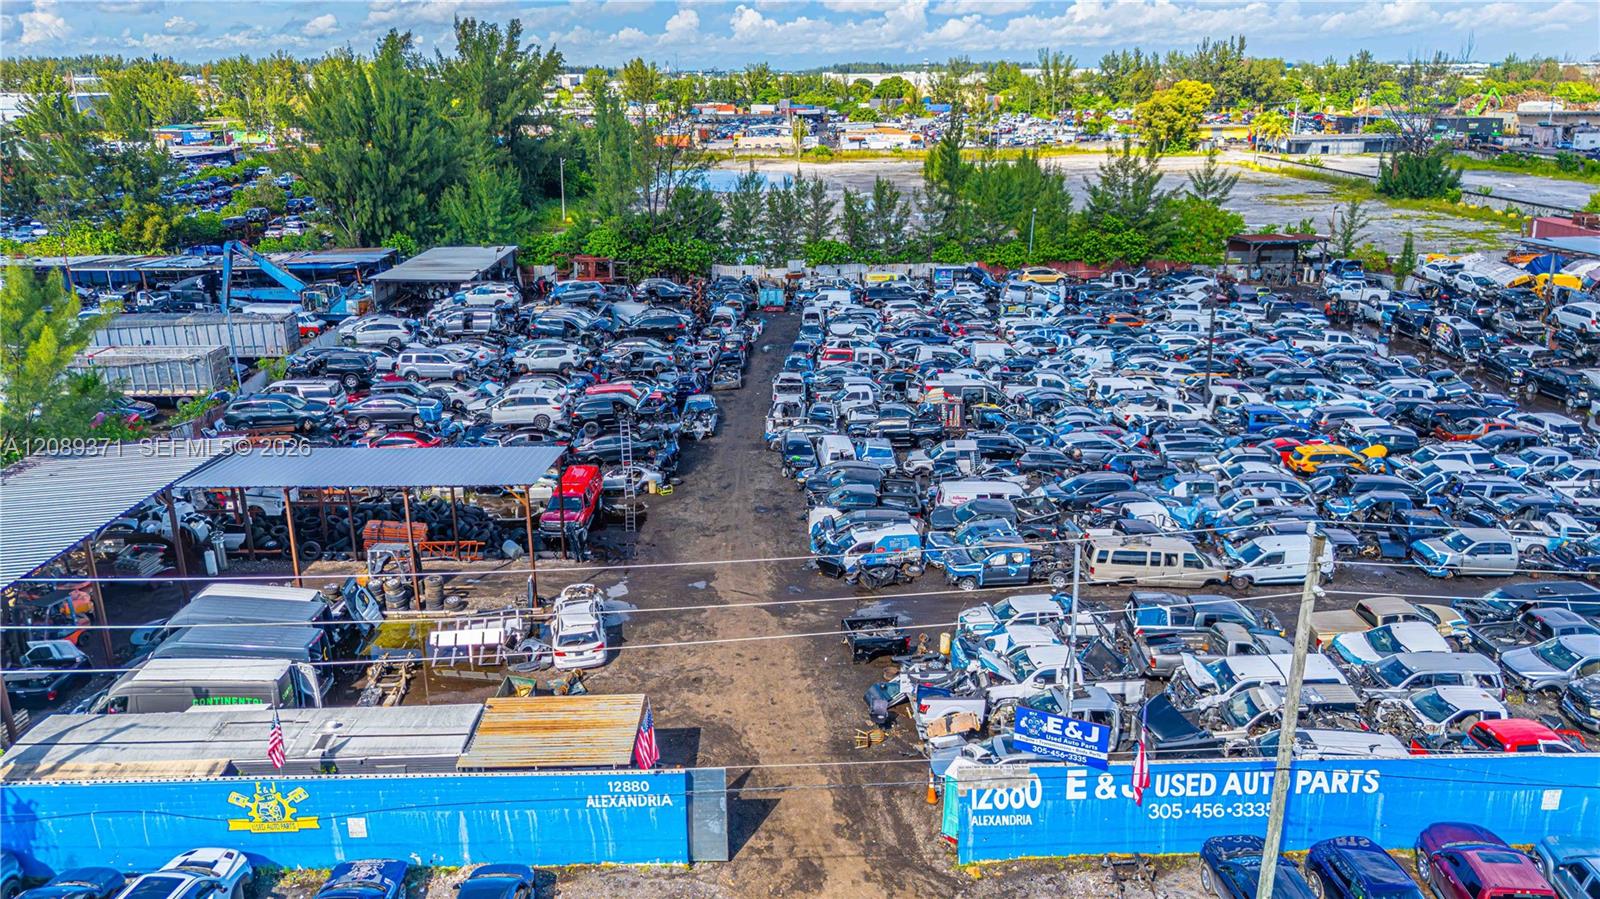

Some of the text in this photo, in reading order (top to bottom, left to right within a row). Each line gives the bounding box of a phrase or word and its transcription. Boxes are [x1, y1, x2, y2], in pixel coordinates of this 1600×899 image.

[1046, 734, 1062, 742] Used
[1081, 742, 1098, 751] Parts
[1032, 745, 1087, 763] 305-456-3335
[608, 781, 650, 792] 12880
[1066, 769, 1088, 800] E
[1095, 773, 1117, 800] &
[1155, 773, 1217, 797] USED
[1221, 771, 1290, 796] AUT
[1295, 769, 1381, 794] PARTS
[586, 794, 673, 808] ALEXANDRIA
[971, 814, 1032, 827] ALEXANDRIA
